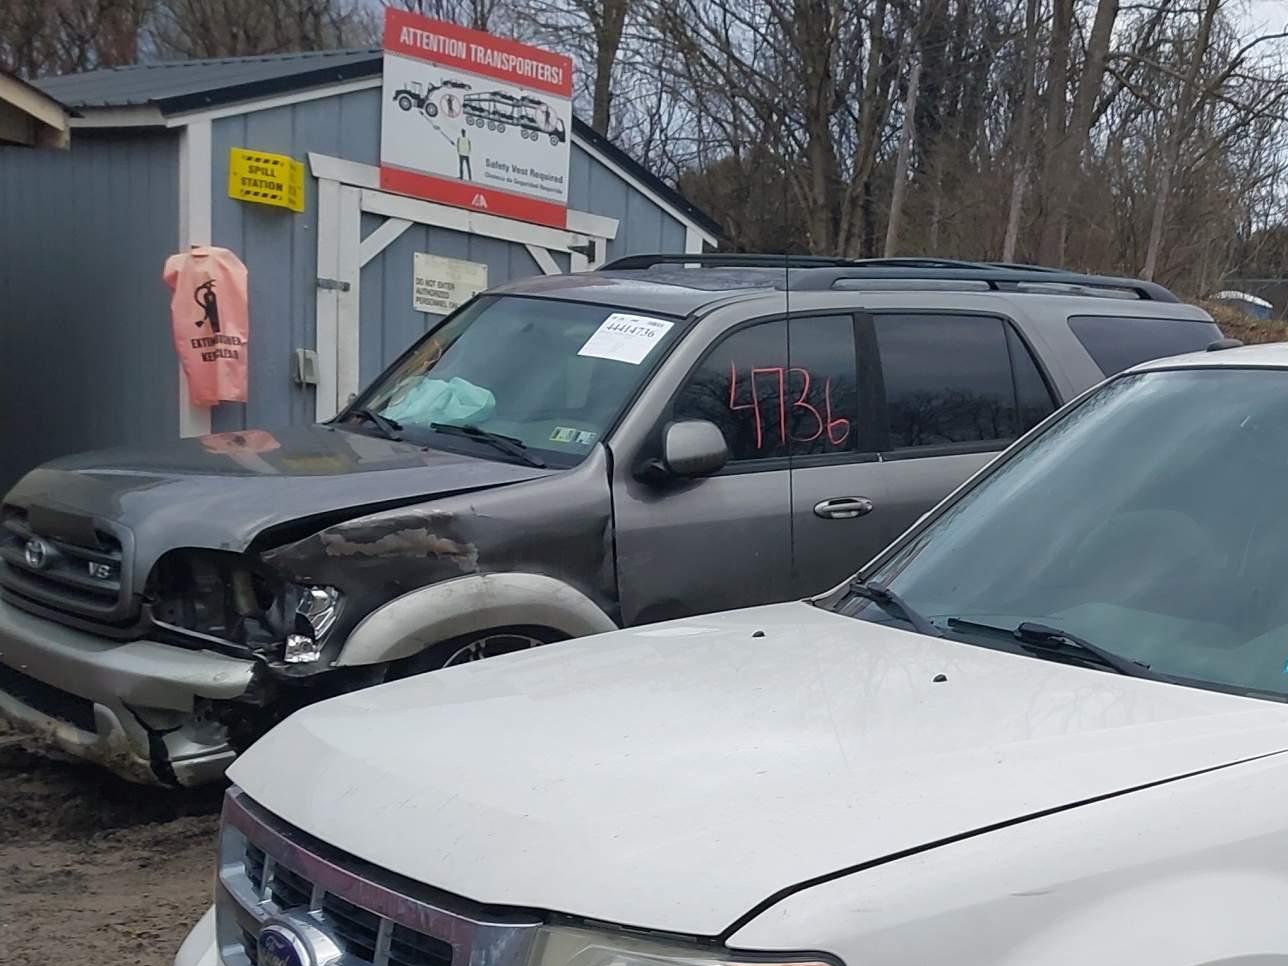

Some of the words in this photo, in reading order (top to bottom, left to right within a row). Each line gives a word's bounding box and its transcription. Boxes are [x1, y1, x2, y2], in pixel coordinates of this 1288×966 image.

[400, 26, 466, 59] ATTENTION
[469, 44, 563, 85] TRANSPORTERS!
[248, 165, 276, 178] SPILL
[241, 176, 283, 192] STATION
[606, 322, 655, 338] 44414736
[730, 360, 849, 449] 4736
